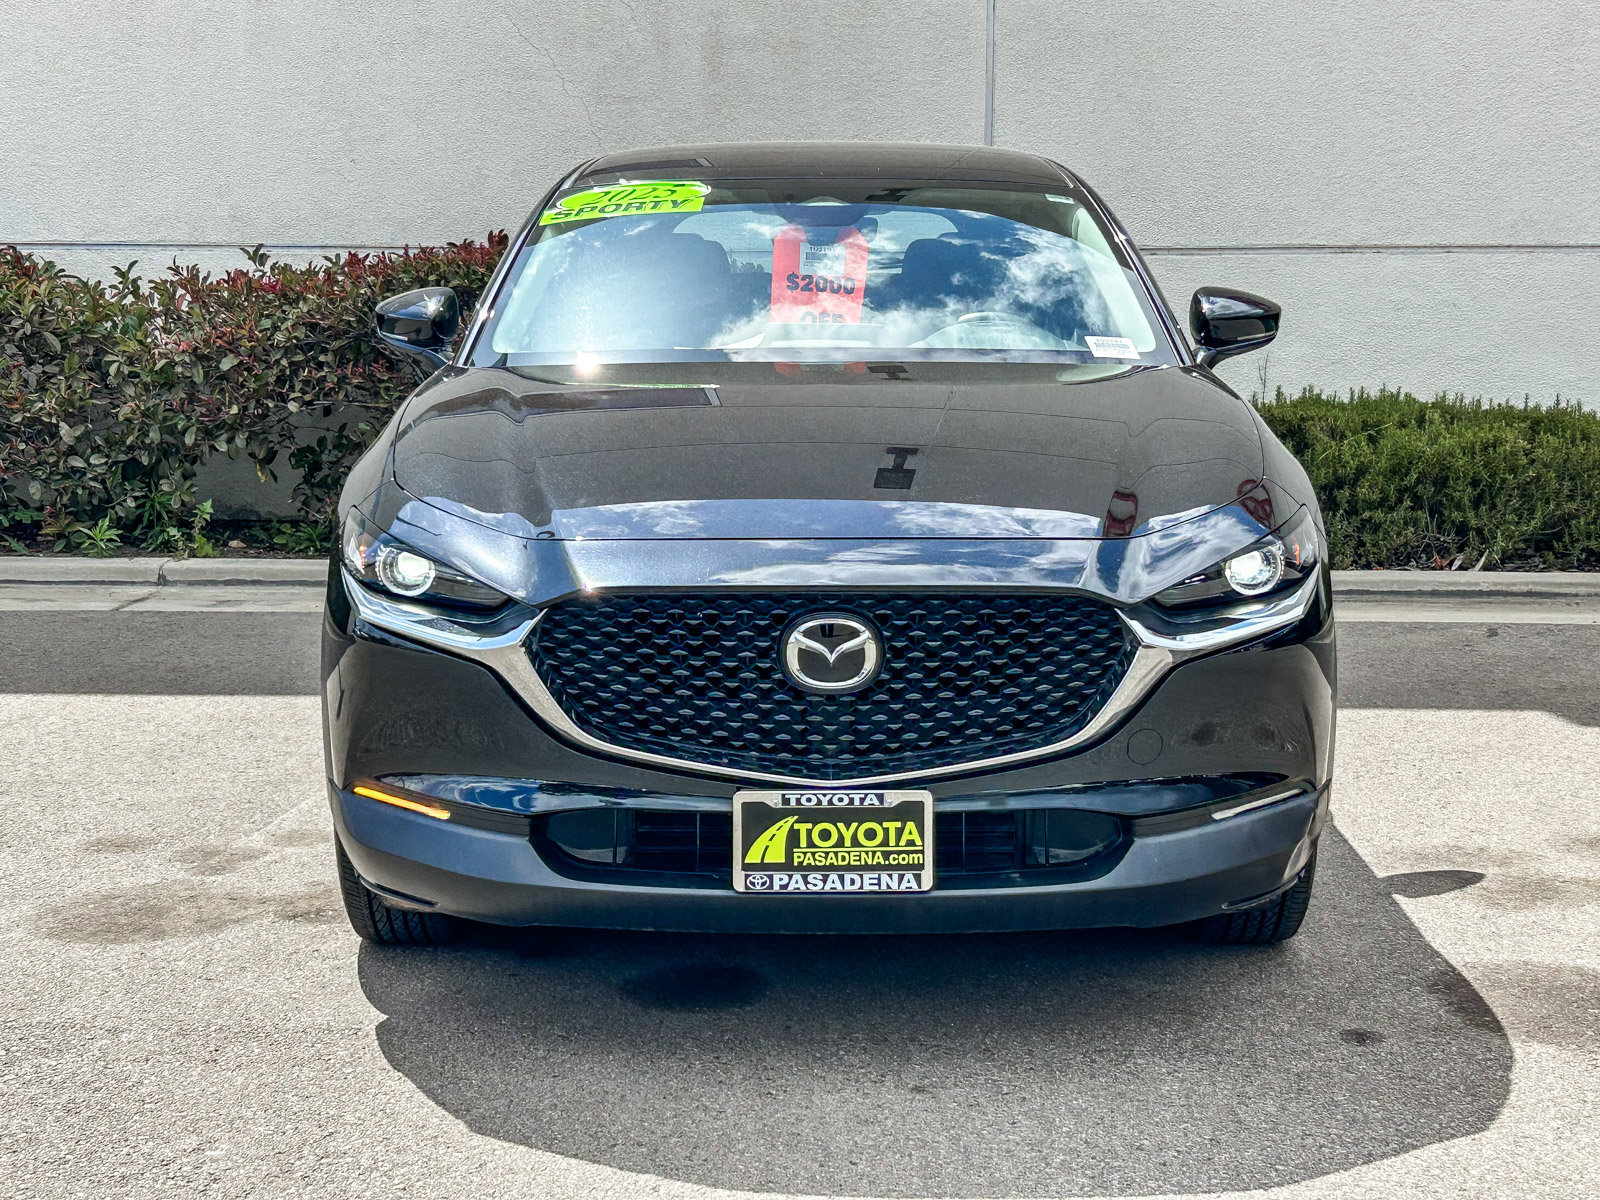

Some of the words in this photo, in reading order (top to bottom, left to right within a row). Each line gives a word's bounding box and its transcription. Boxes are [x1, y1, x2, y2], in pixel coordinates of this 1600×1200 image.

[581, 184, 687, 207] 2025
[550, 199, 695, 220] SPORTY
[786, 271, 855, 295] $2000
[785, 794, 880, 806] TOYOTA
[793, 821, 923, 848] TOYOTA
[793, 851, 923, 866] PASADENA.com
[772, 873, 919, 891] PASADENA
